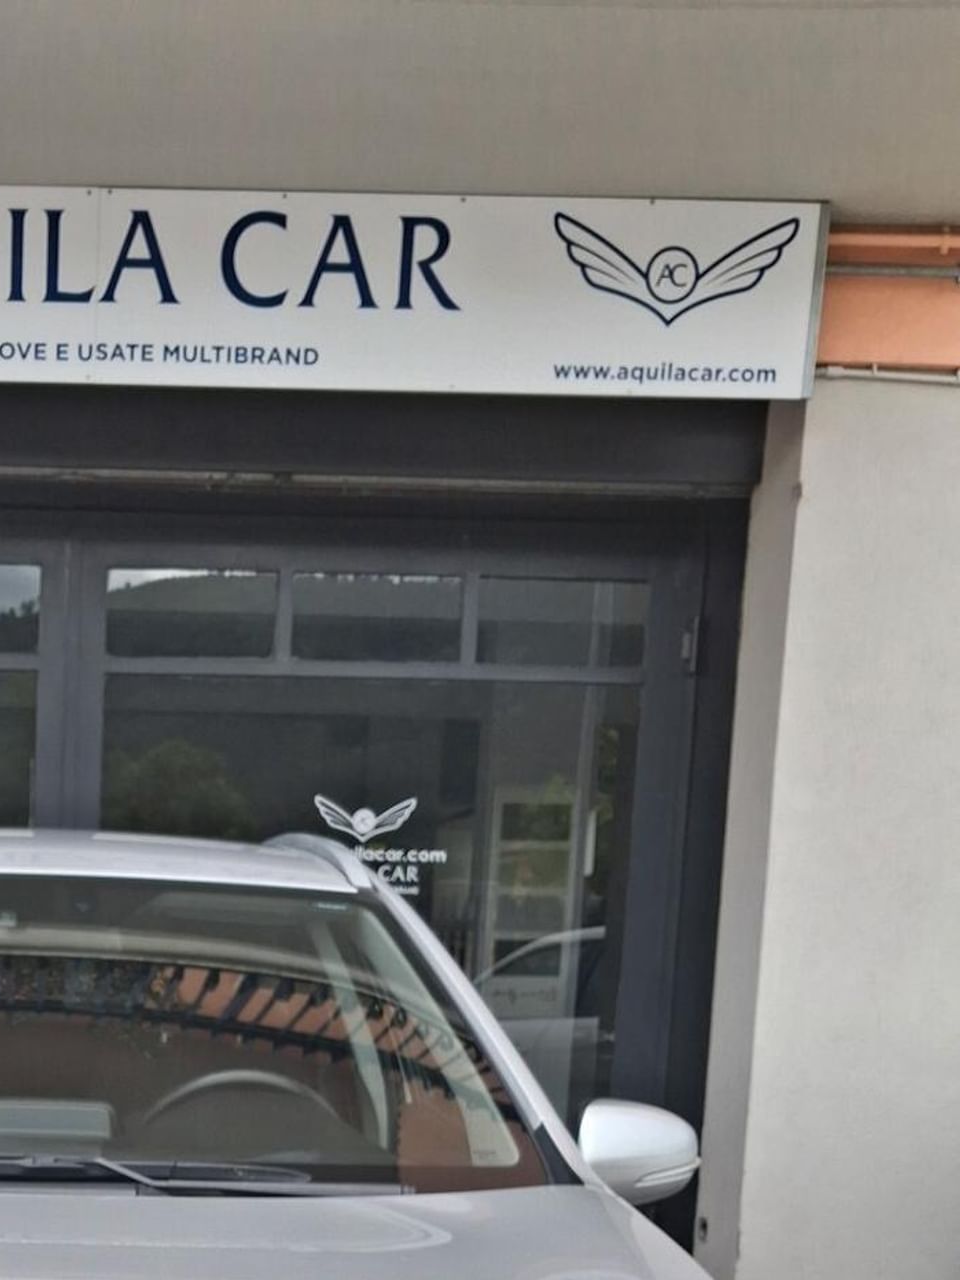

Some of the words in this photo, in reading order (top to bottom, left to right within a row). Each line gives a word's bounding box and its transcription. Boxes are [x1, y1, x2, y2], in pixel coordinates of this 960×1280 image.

[220, 210, 463, 312] CAR
[54, 342, 69, 361] E
[77, 342, 154, 362] USATE
[162, 344, 319, 366] MULTIBRAND
[553, 360, 778, 384] www.aquilacar.com
[377, 864, 420, 883] CAR
